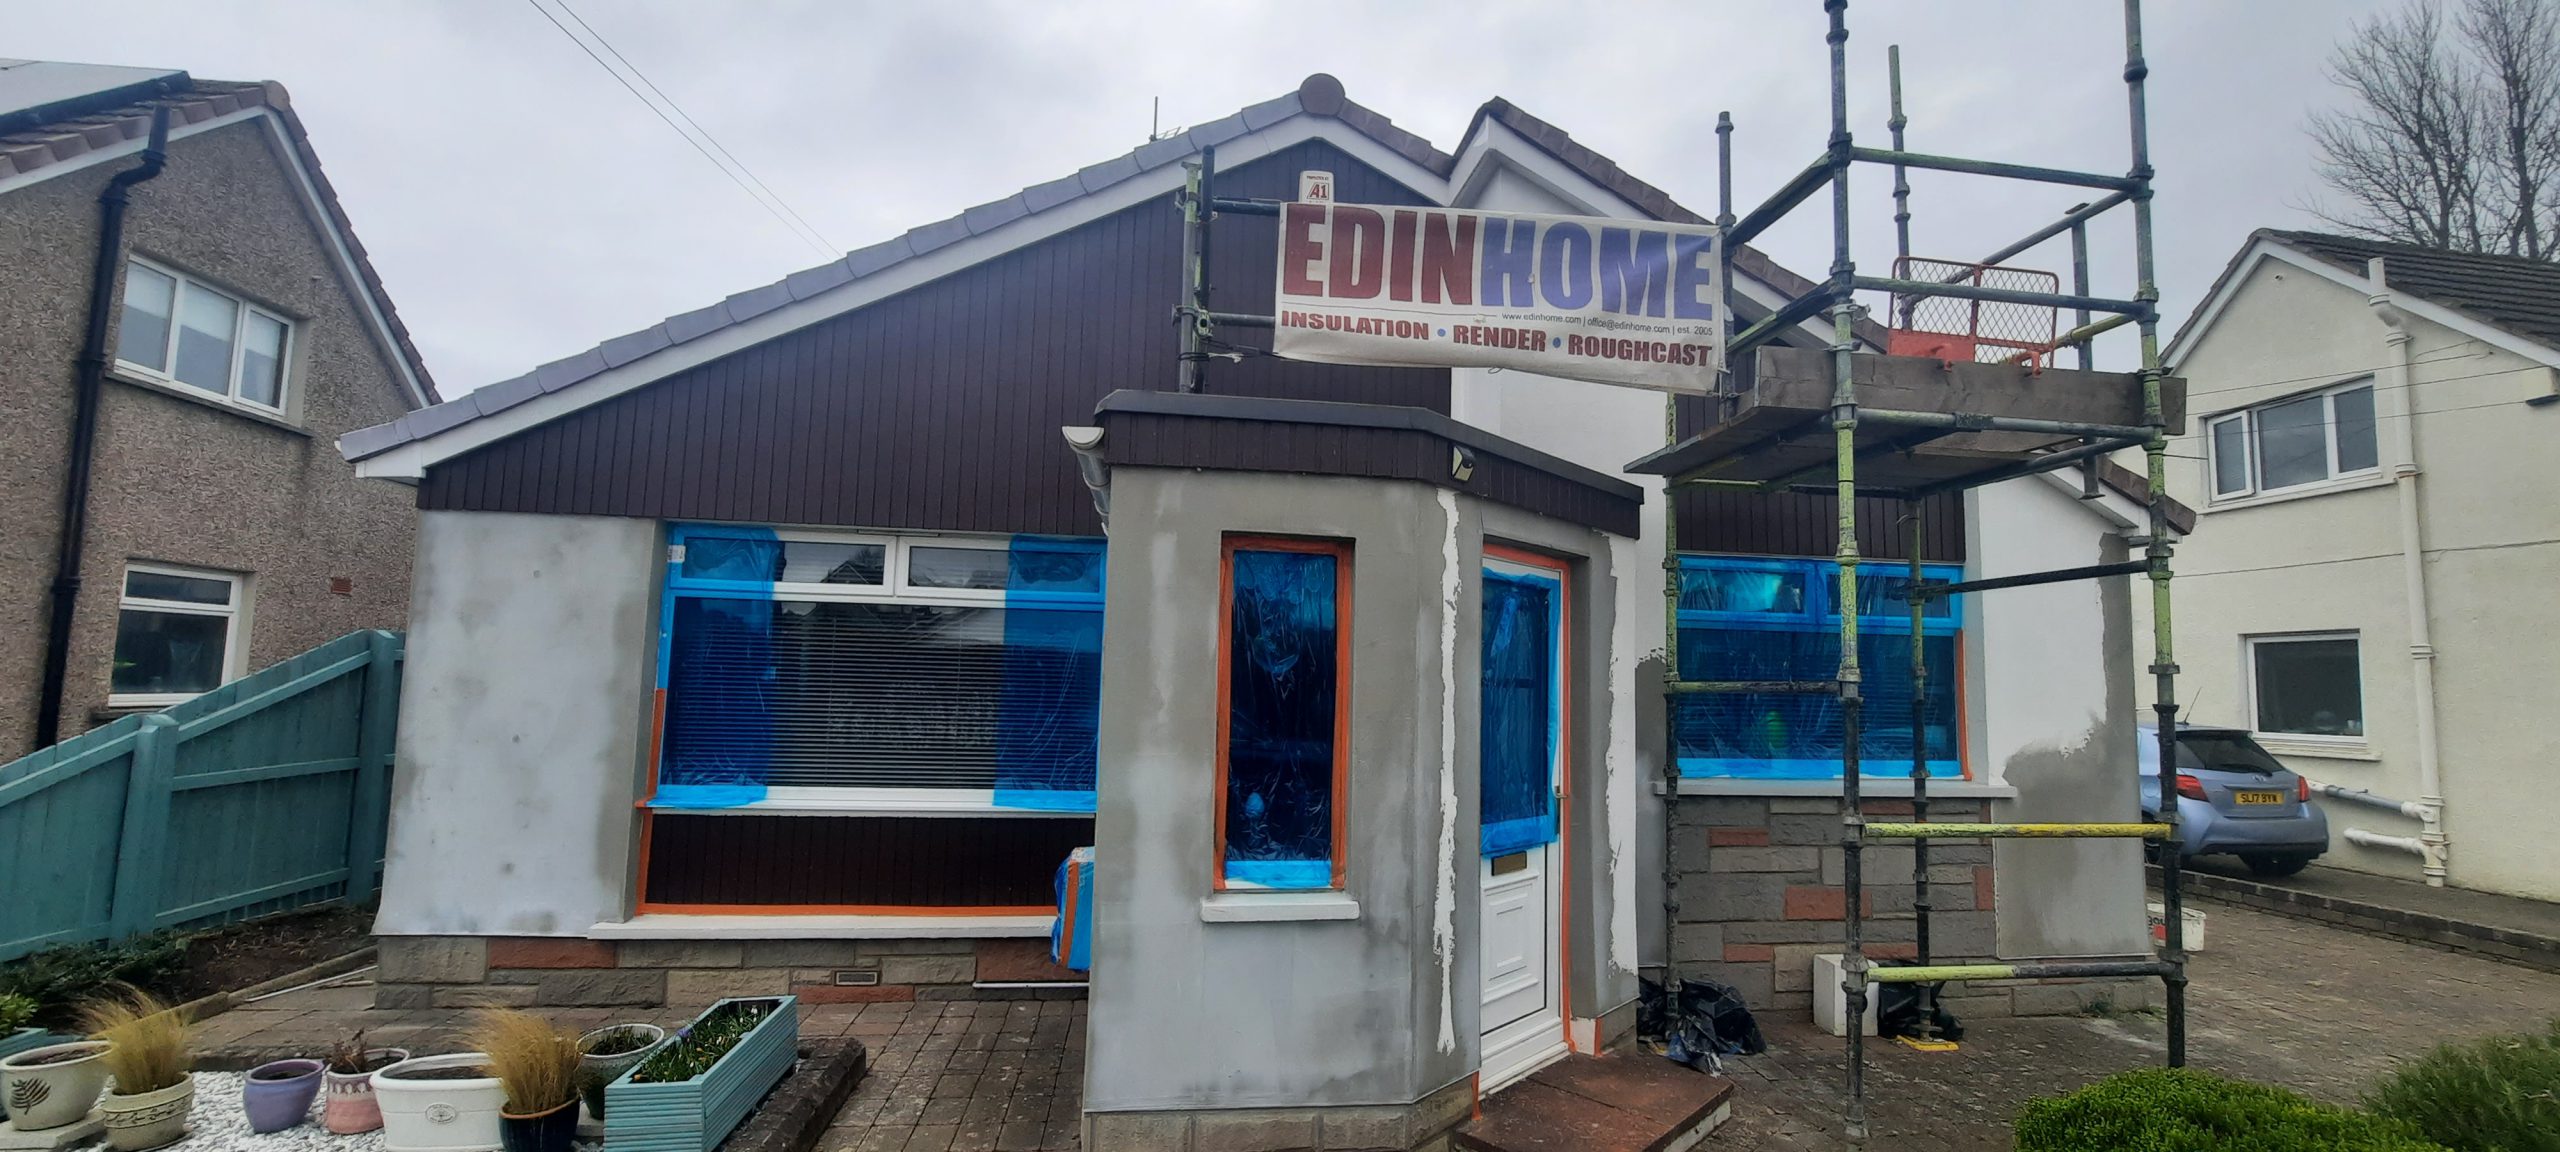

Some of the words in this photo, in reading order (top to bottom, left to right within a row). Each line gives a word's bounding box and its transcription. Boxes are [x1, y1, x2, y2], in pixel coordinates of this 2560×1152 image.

[1310, 184, 1327, 198] A1
[1282, 204, 1713, 321] EDINHOME
[1281, 310, 1429, 340] INSULATION
[1453, 326, 1547, 352] RENDER
[1567, 334, 1712, 367] ROUGHCAST
[1502, 312, 1582, 325] www.edinhome.com
[1587, 318, 1670, 333] office@edinhome.com
[1694, 326, 1713, 336] 2005
